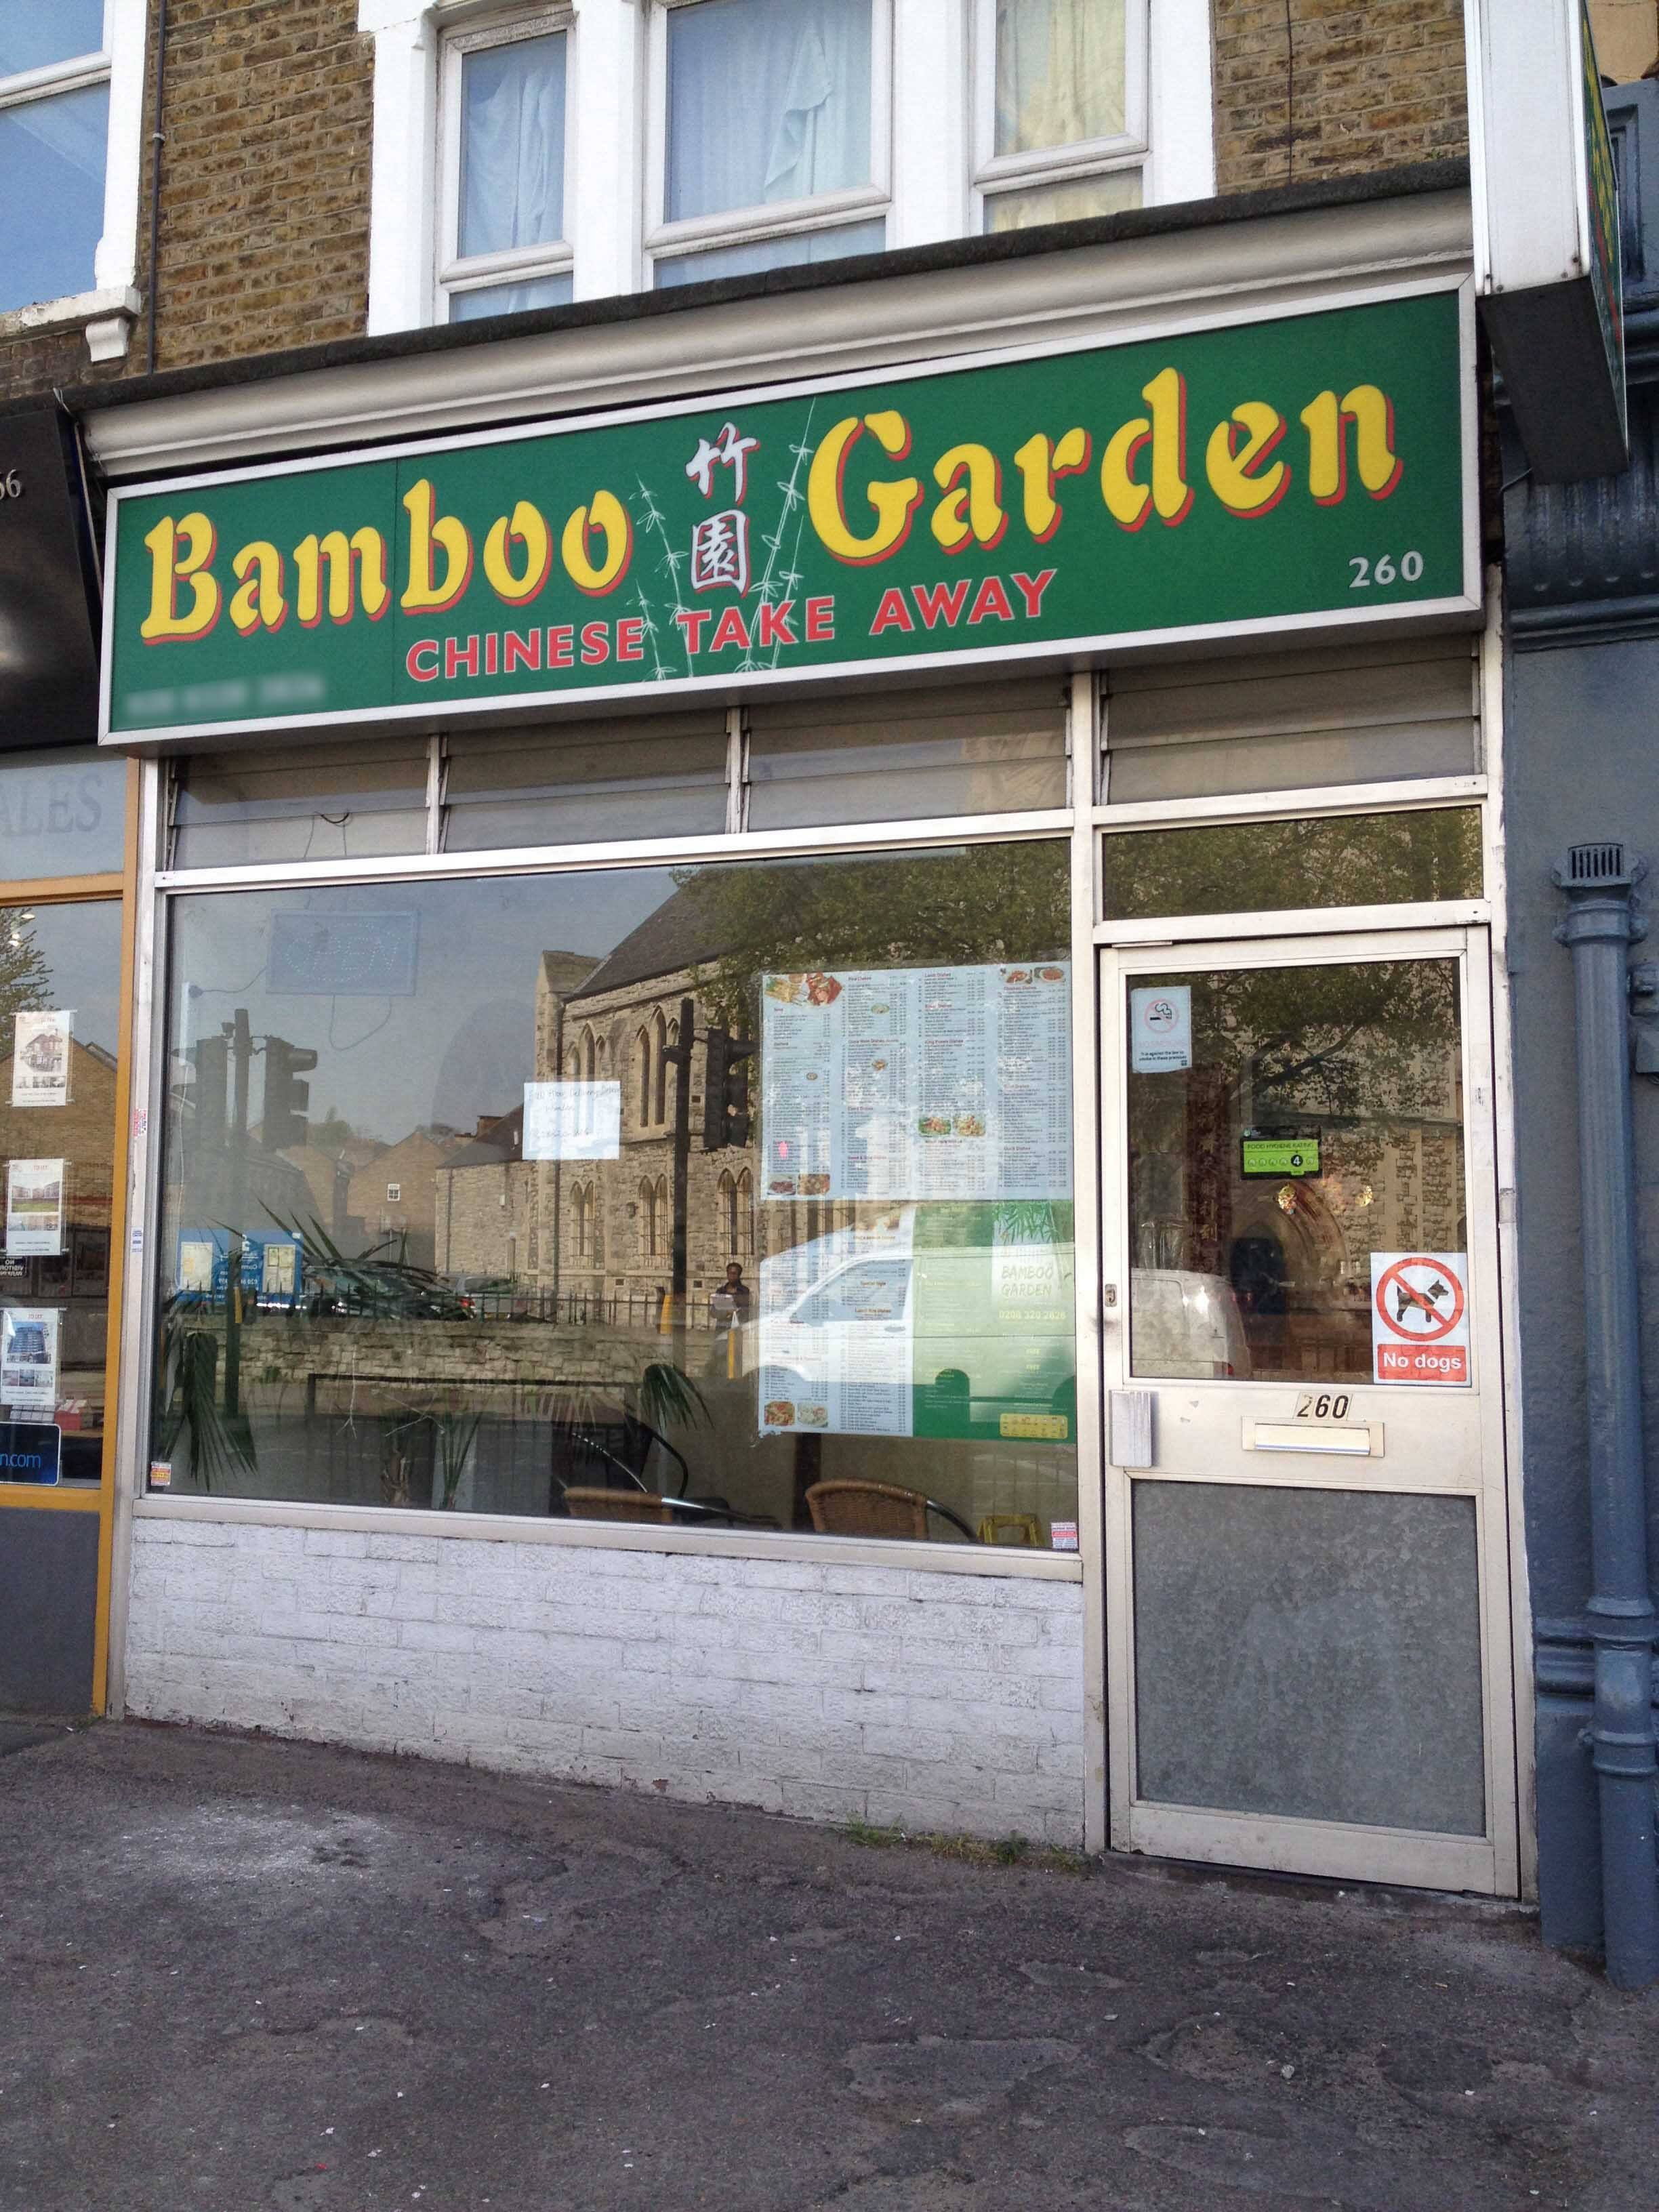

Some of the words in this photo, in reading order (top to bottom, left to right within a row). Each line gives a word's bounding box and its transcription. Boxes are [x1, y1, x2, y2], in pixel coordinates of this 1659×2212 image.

[0, 470, 20, 499] 6
[140, 478, 633, 645] Bamboo
[807, 367, 1403, 566] Garden
[686, 422, 760, 598] 竹園
[1349, 550, 1424, 588] 260
[406, 617, 644, 682] CHINESE
[677, 596, 836, 655] TAKE
[869, 569, 1057, 636] AWAY
[1001, 1265, 1053, 1280] BAMBOO
[1001, 1283, 1052, 1298] GARDEN
[1383, 1353, 1408, 1368] No
[1414, 1353, 1462, 1372] dogs
[1296, 1394, 1349, 1418] 260
